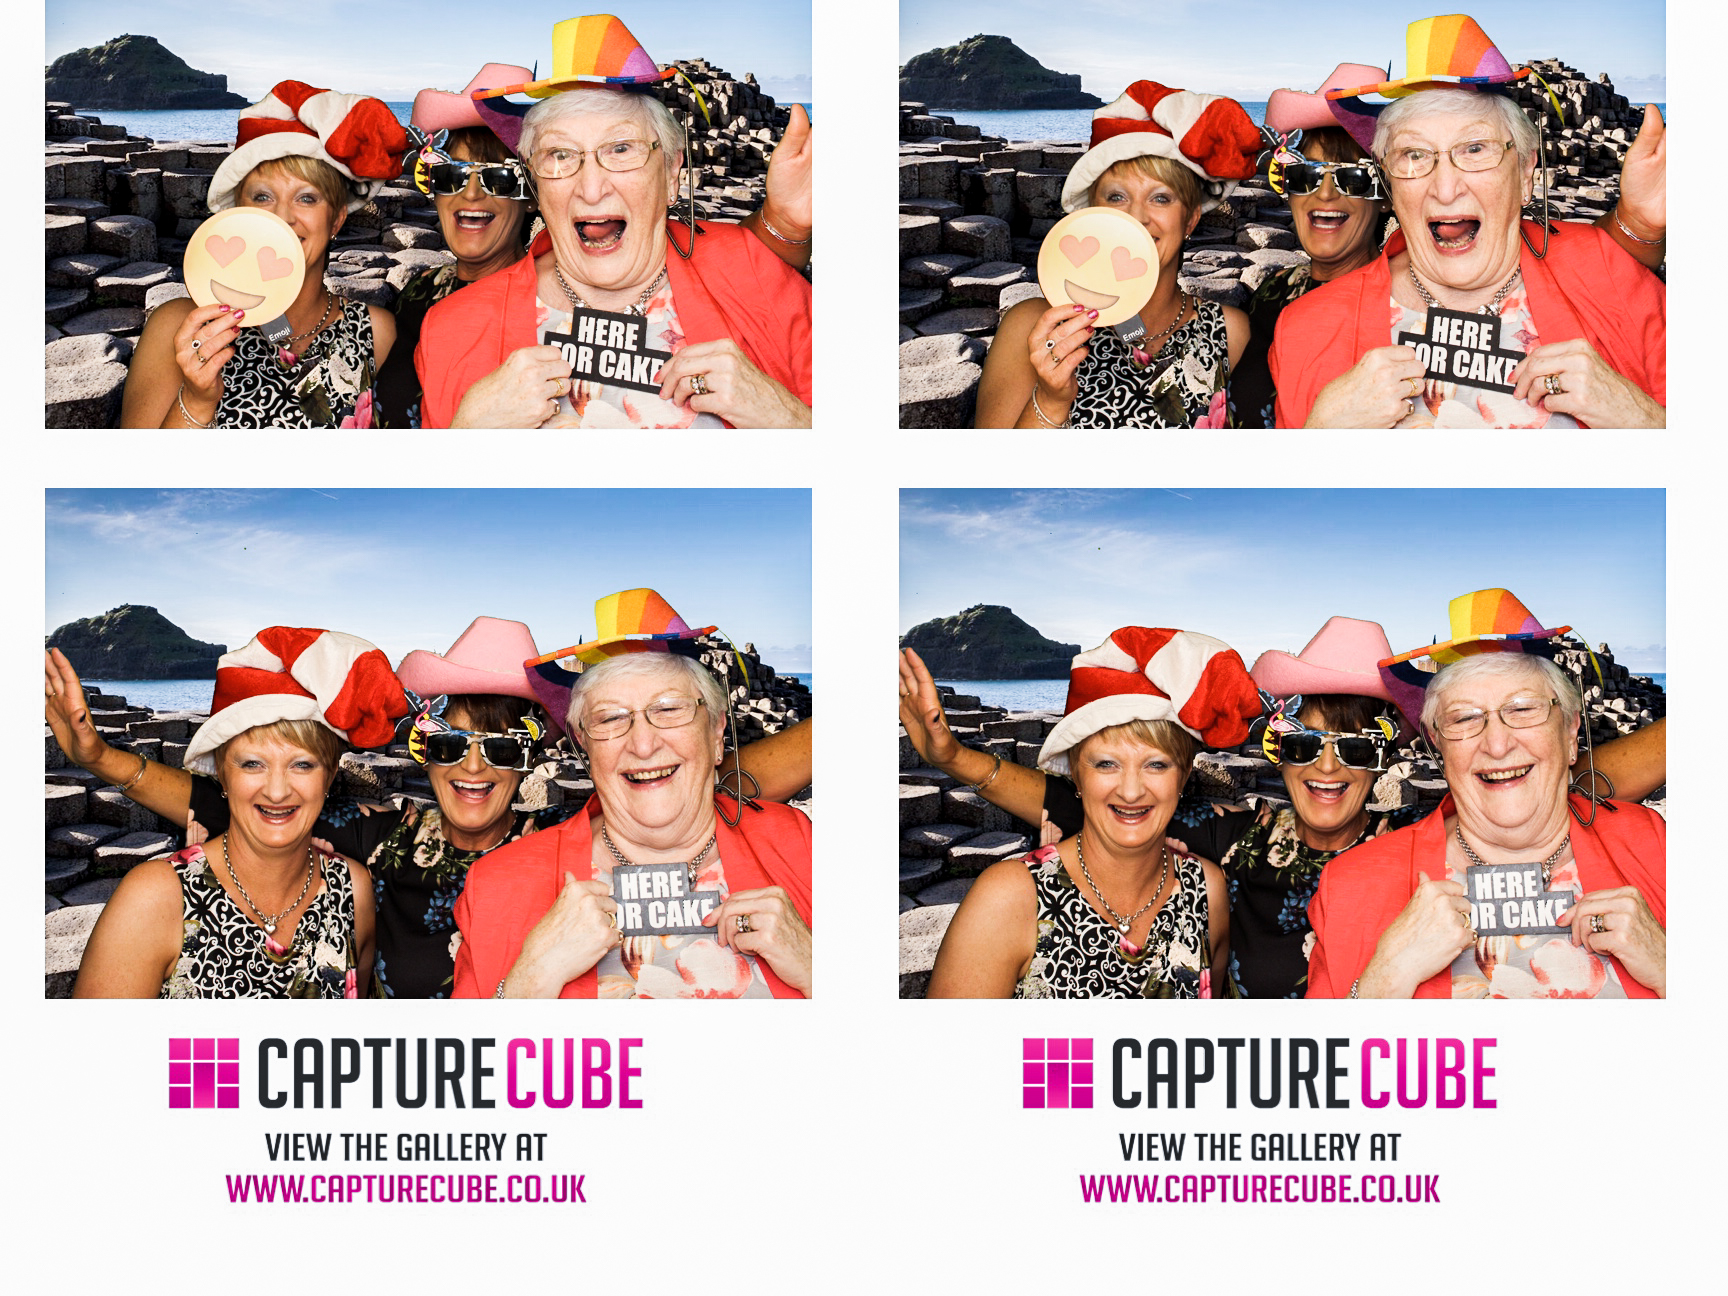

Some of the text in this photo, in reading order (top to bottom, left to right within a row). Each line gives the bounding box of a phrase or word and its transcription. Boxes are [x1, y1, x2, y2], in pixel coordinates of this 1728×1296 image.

[268, 326, 291, 342] Emoji
[577, 315, 639, 351] HERE
[1122, 326, 1145, 342] Emoji
[1431, 315, 1493, 351] HERE
[550, 340, 594, 374] OR
[1404, 340, 1448, 374] OR
[620, 870, 685, 900] HERE
[1474, 870, 1539, 900] HERE
